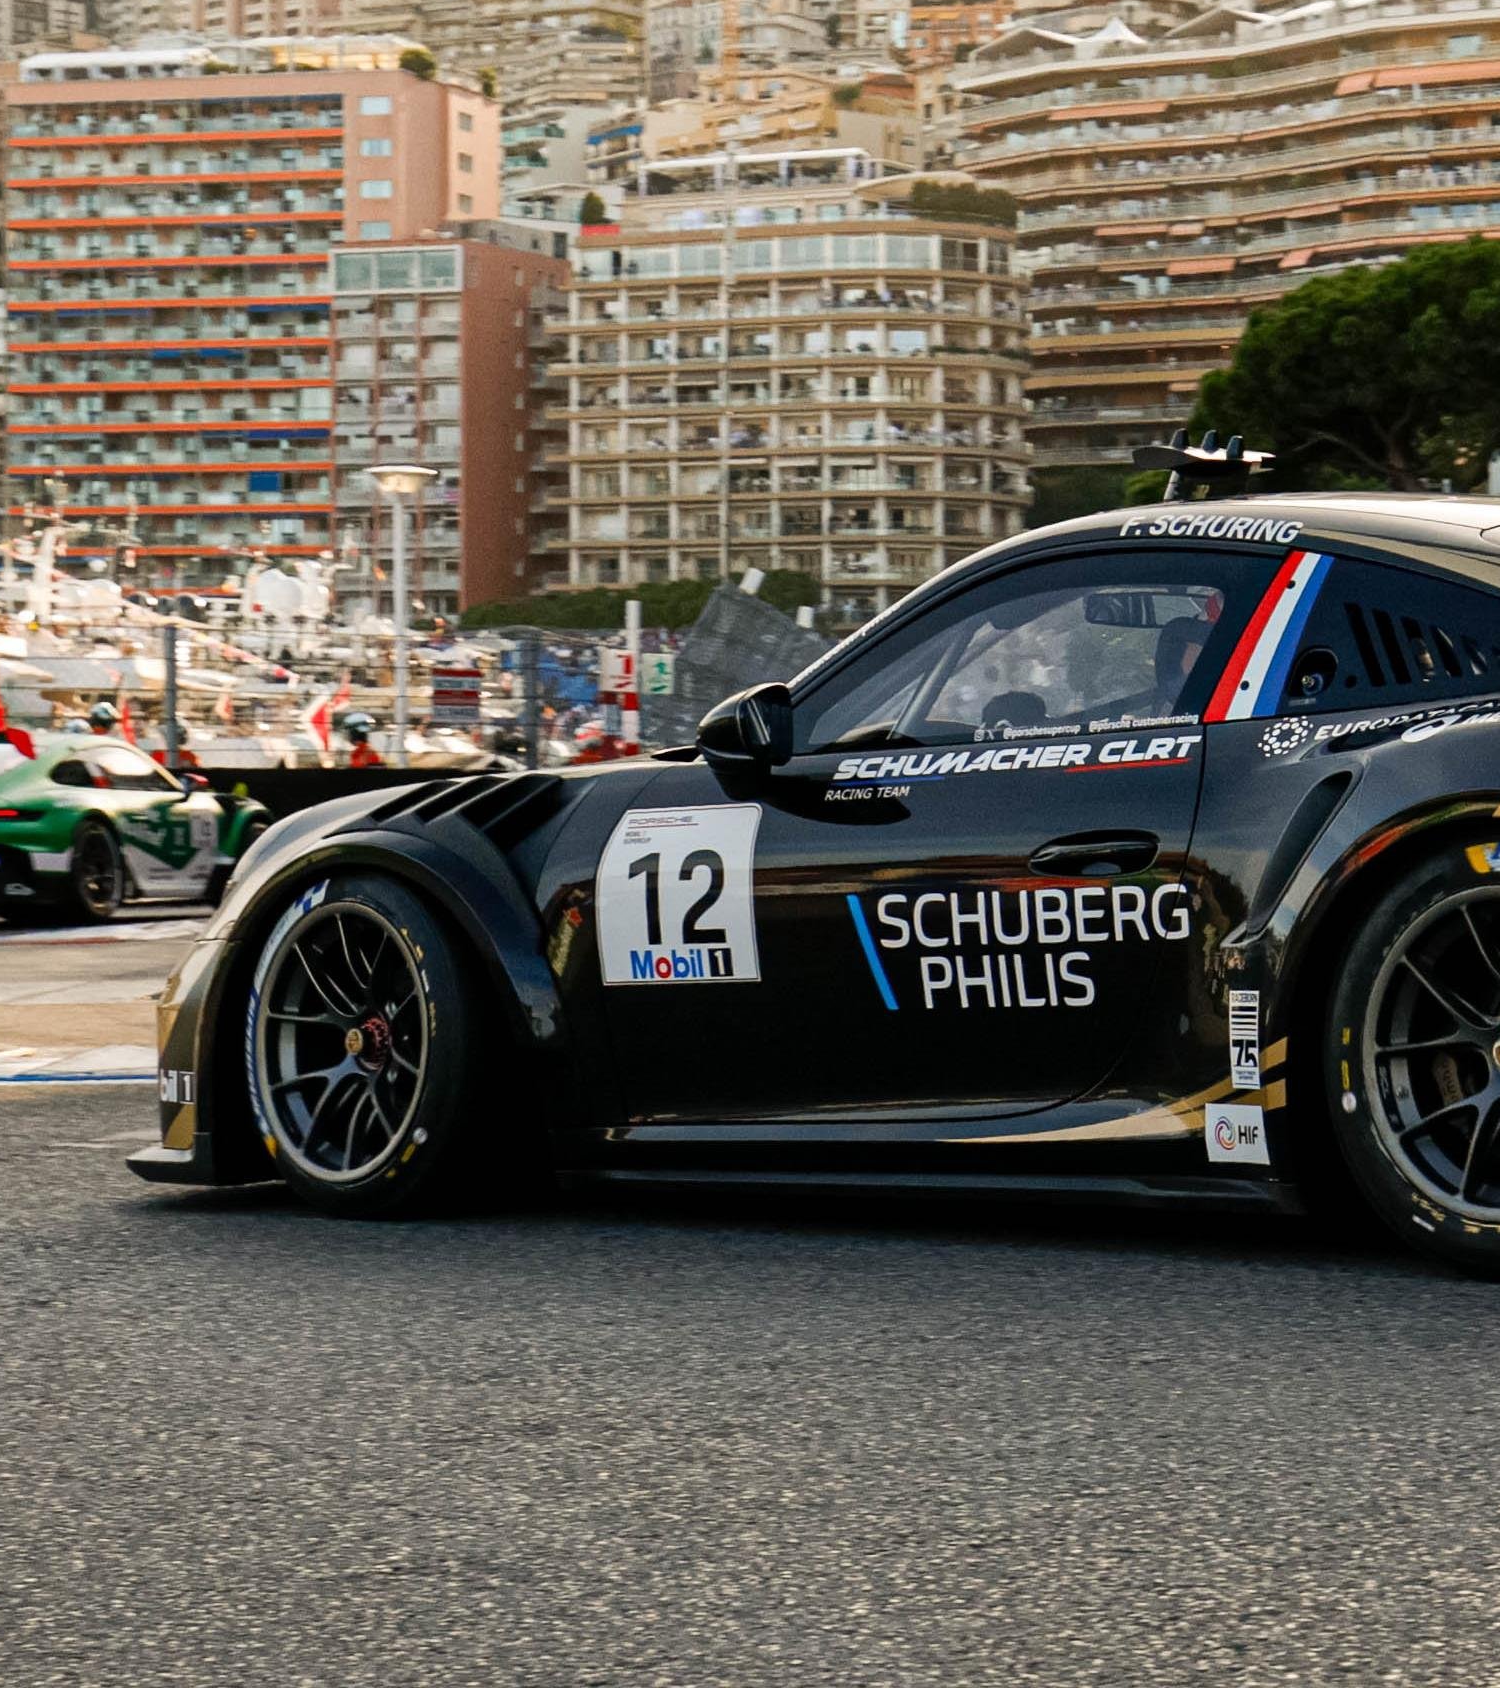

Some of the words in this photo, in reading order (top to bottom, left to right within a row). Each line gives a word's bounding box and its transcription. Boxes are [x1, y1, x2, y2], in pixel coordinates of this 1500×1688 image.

[1119, 515, 1145, 537] F.
[1149, 514, 1304, 544] SCHURING
[832, 743, 1088, 781] SCHUMACHER
[1097, 735, 1202, 764] CLRT
[825, 787, 873, 801] RACING
[876, 785, 911, 799] TEAM
[628, 848, 727, 946] 12
[876, 883, 1192, 950] SCHUBERG
[629, 948, 704, 980] Mobil
[711, 949, 729, 976] 1
[920, 951, 1096, 1010] PHILIS
[1232, 1039, 1258, 1068] 75
[1237, 1124, 1260, 1146] HIF
